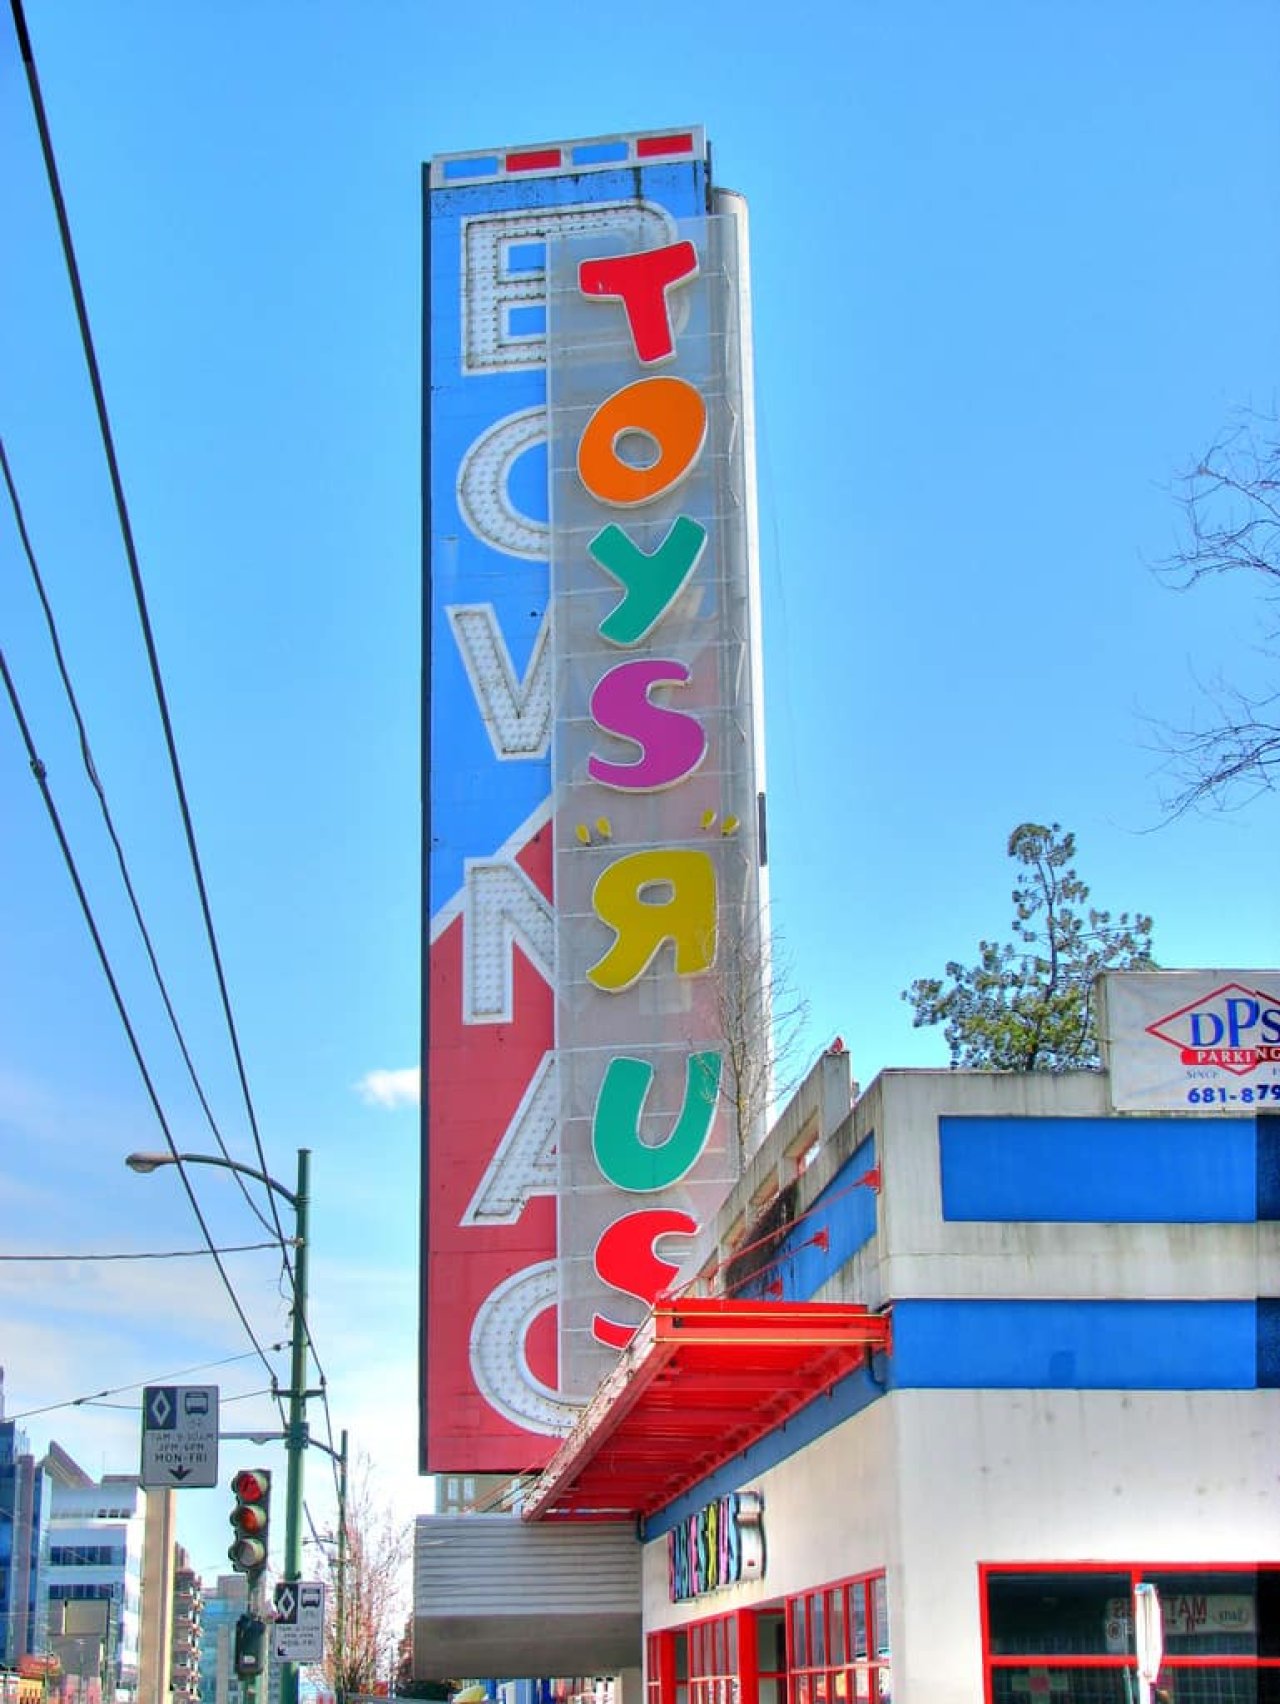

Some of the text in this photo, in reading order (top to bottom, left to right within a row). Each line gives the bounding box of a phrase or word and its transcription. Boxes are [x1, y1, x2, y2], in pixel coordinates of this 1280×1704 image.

[576, 238, 709, 793] TOYS
[591, 1050, 721, 1352] US
[1197, 1048, 1280, 1063] PARKING
